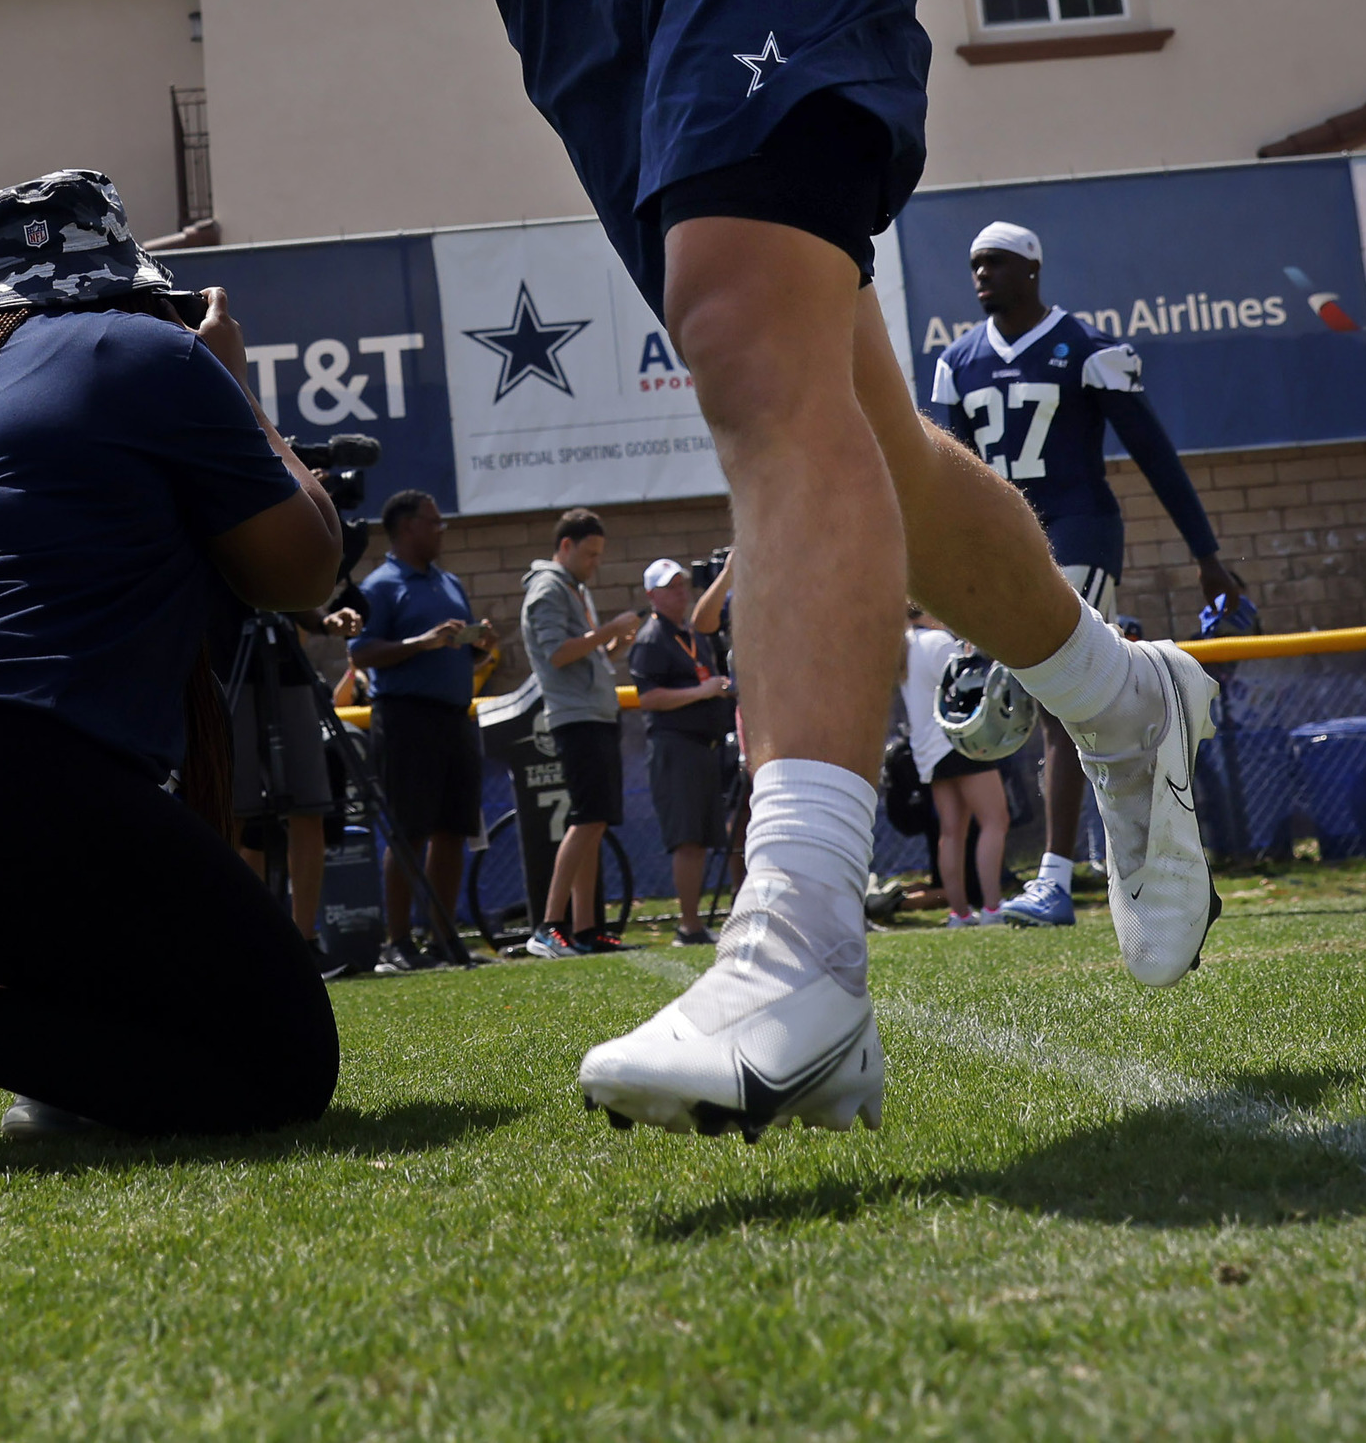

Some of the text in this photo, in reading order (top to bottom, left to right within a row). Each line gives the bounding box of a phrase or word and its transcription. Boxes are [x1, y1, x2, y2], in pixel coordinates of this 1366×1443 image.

[29, 231, 46, 244] NFL
[1127, 292, 1287, 337] Airlines
[963, 382, 1060, 480] 27
[471, 453, 497, 471] THE
[499, 448, 555, 470] OFFICIAL
[558, 443, 622, 464] SPORTING
[626, 439, 671, 458] GOODS
[537, 789, 572, 842] 7
